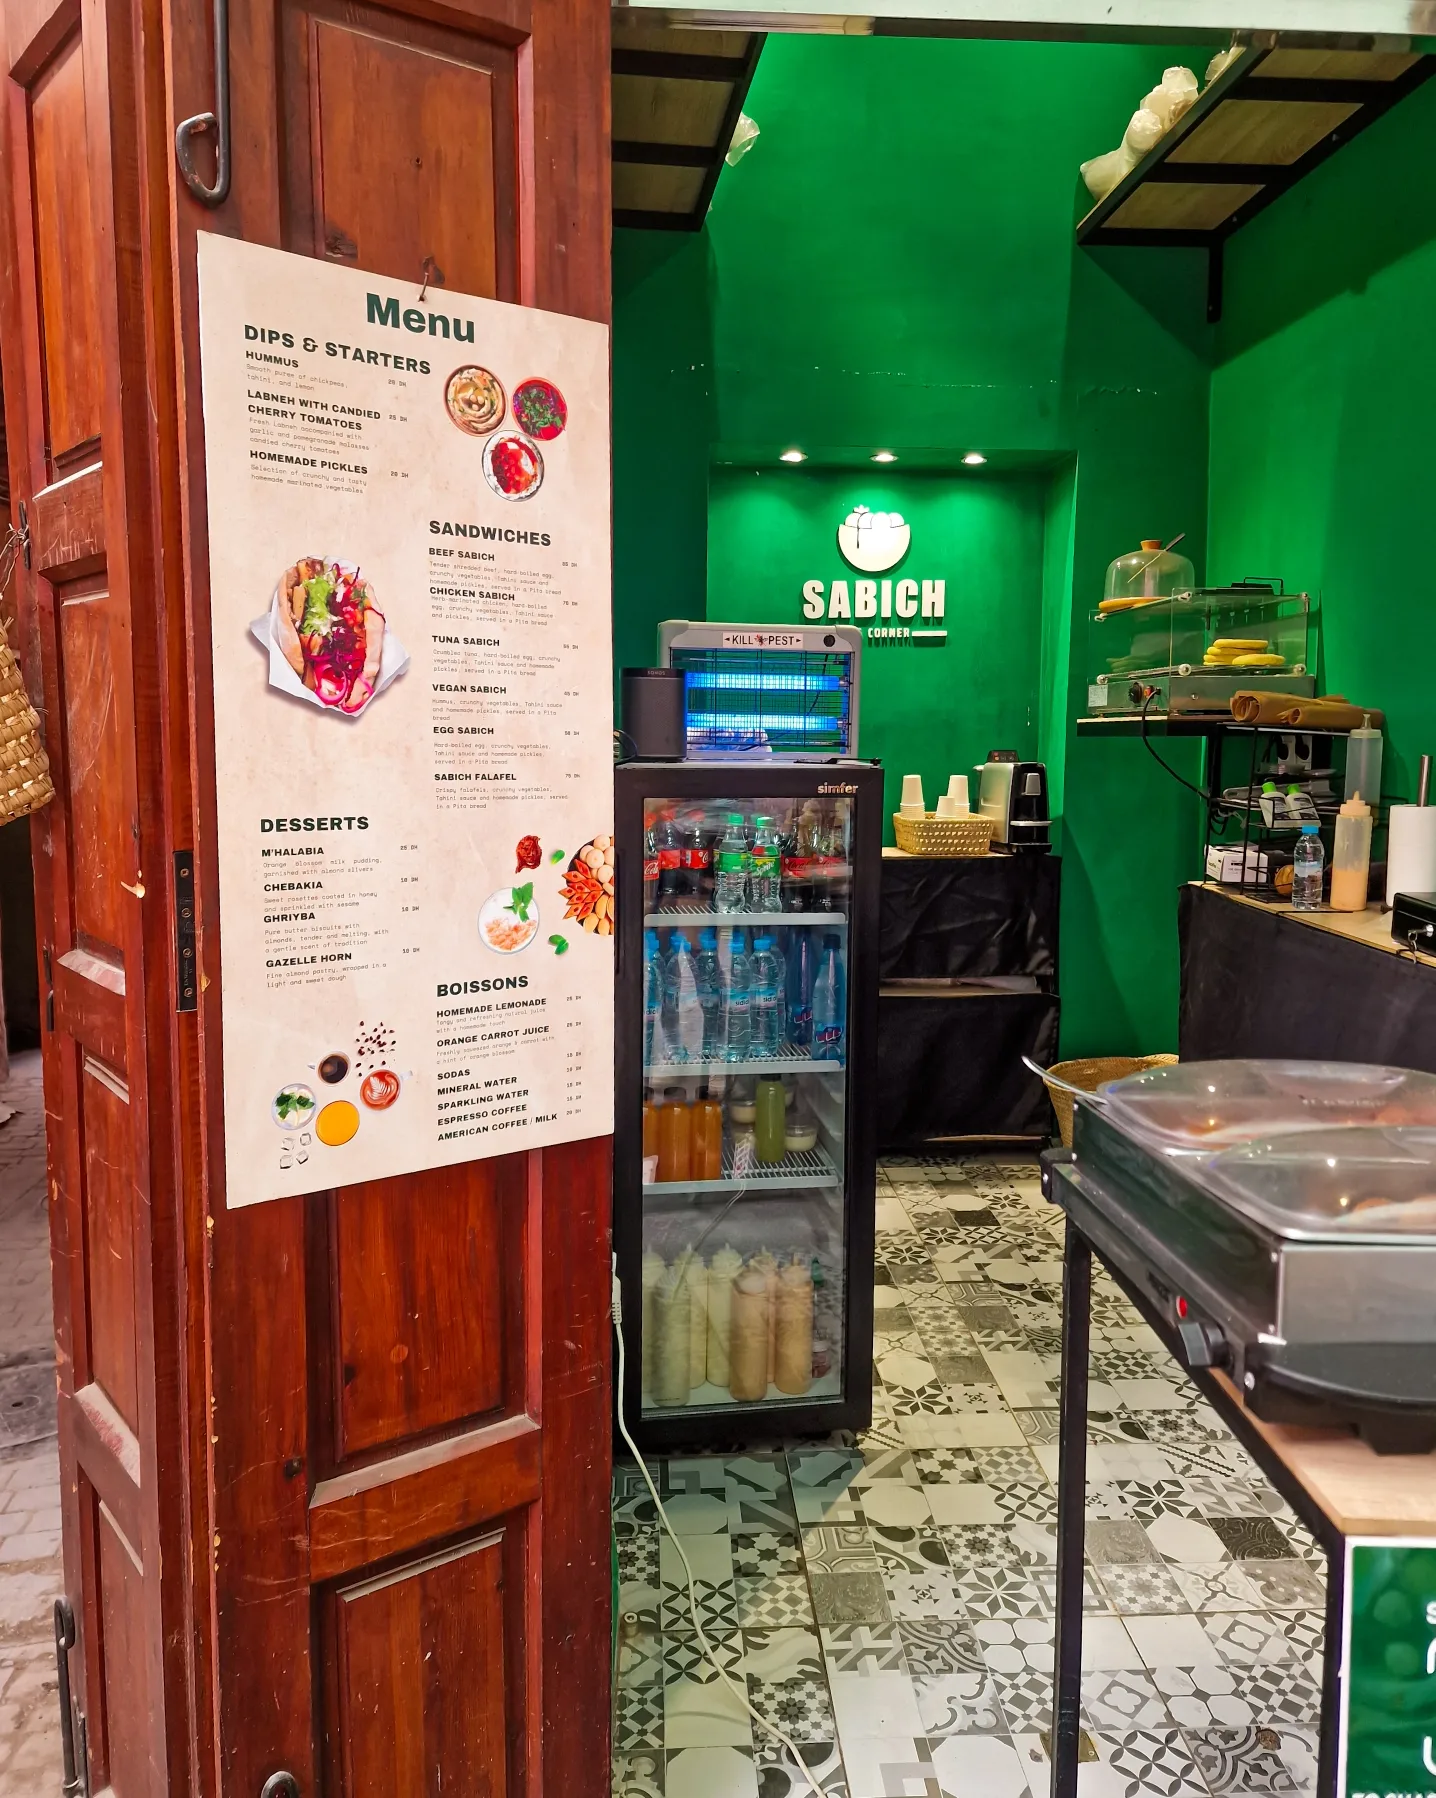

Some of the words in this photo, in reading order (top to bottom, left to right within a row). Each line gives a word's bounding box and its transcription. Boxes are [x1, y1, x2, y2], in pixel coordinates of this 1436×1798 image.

[366, 292, 475, 343] Menu
[244, 325, 295, 348] DIPS
[303, 338, 318, 353] &
[325, 342, 431, 375] STARTERS
[245, 351, 299, 368] HUMMUS
[247, 389, 295, 405] LABNEH
[299, 399, 328, 411] WITH
[332, 404, 381, 419] CANDIED
[248, 404, 296, 420] CHERRY
[300, 414, 362, 431] TOMATOES
[250, 450, 317, 468] HOMEMADE
[321, 461, 368, 475] PICKLES
[429, 520, 551, 547] SANDWICHES
[429, 547, 455, 557] BEEF
[458, 551, 495, 561] SABICH
[430, 587, 475, 598] CHICKEN
[479, 591, 515, 601] SABICH
[802, 579, 946, 619] SABICH
[432, 635, 460, 644] TUNA
[463, 637, 500, 647] SABICH
[732, 634, 753, 645] KILL
[768, 635, 794, 646] PEST
[867, 628, 910, 638] CORNER
[432, 684, 467, 693] VEGAN
[470, 686, 507, 694] SABICH
[433, 726, 455, 734] EGG
[457, 727, 494, 735] SABICH
[434, 773, 472, 781] SABICH
[475, 773, 517, 781] FALAFEL
[817, 781, 859, 794] simfer
[261, 816, 369, 833] DESSERTS
[262, 847, 324, 857] M'HALABIA
[264, 881, 323, 892] CHEBAKIA
[264, 912, 316, 923] GHRIYBA
[266, 956, 317, 968] GAZELLE
[321, 953, 352, 963] HORN
[437, 975, 529, 997] BOISSONS
[436, 1005, 493, 1018] HOMEMADE
[495, 998, 547, 1011] LEMONADE
[437, 1035, 478, 1047] ORANGE
[481, 1029, 519, 1041] CARROT
[522, 1026, 550, 1036] JUICE
[437, 1068, 471, 1080] SODAS
[437, 1082, 482, 1096] MINERAL
[484, 1076, 518, 1088] WATER
[437, 1095, 493, 1111] SPARKLING
[496, 1089, 529, 1101] WATER
[437, 1111, 488, 1126] ESPRESSO
[491, 1104, 527, 1116] COFFEE
[437, 1126, 489, 1141] AMERICAN
[492, 1119, 528, 1131] COFFEE
[535, 1113, 558, 1123] MILK
